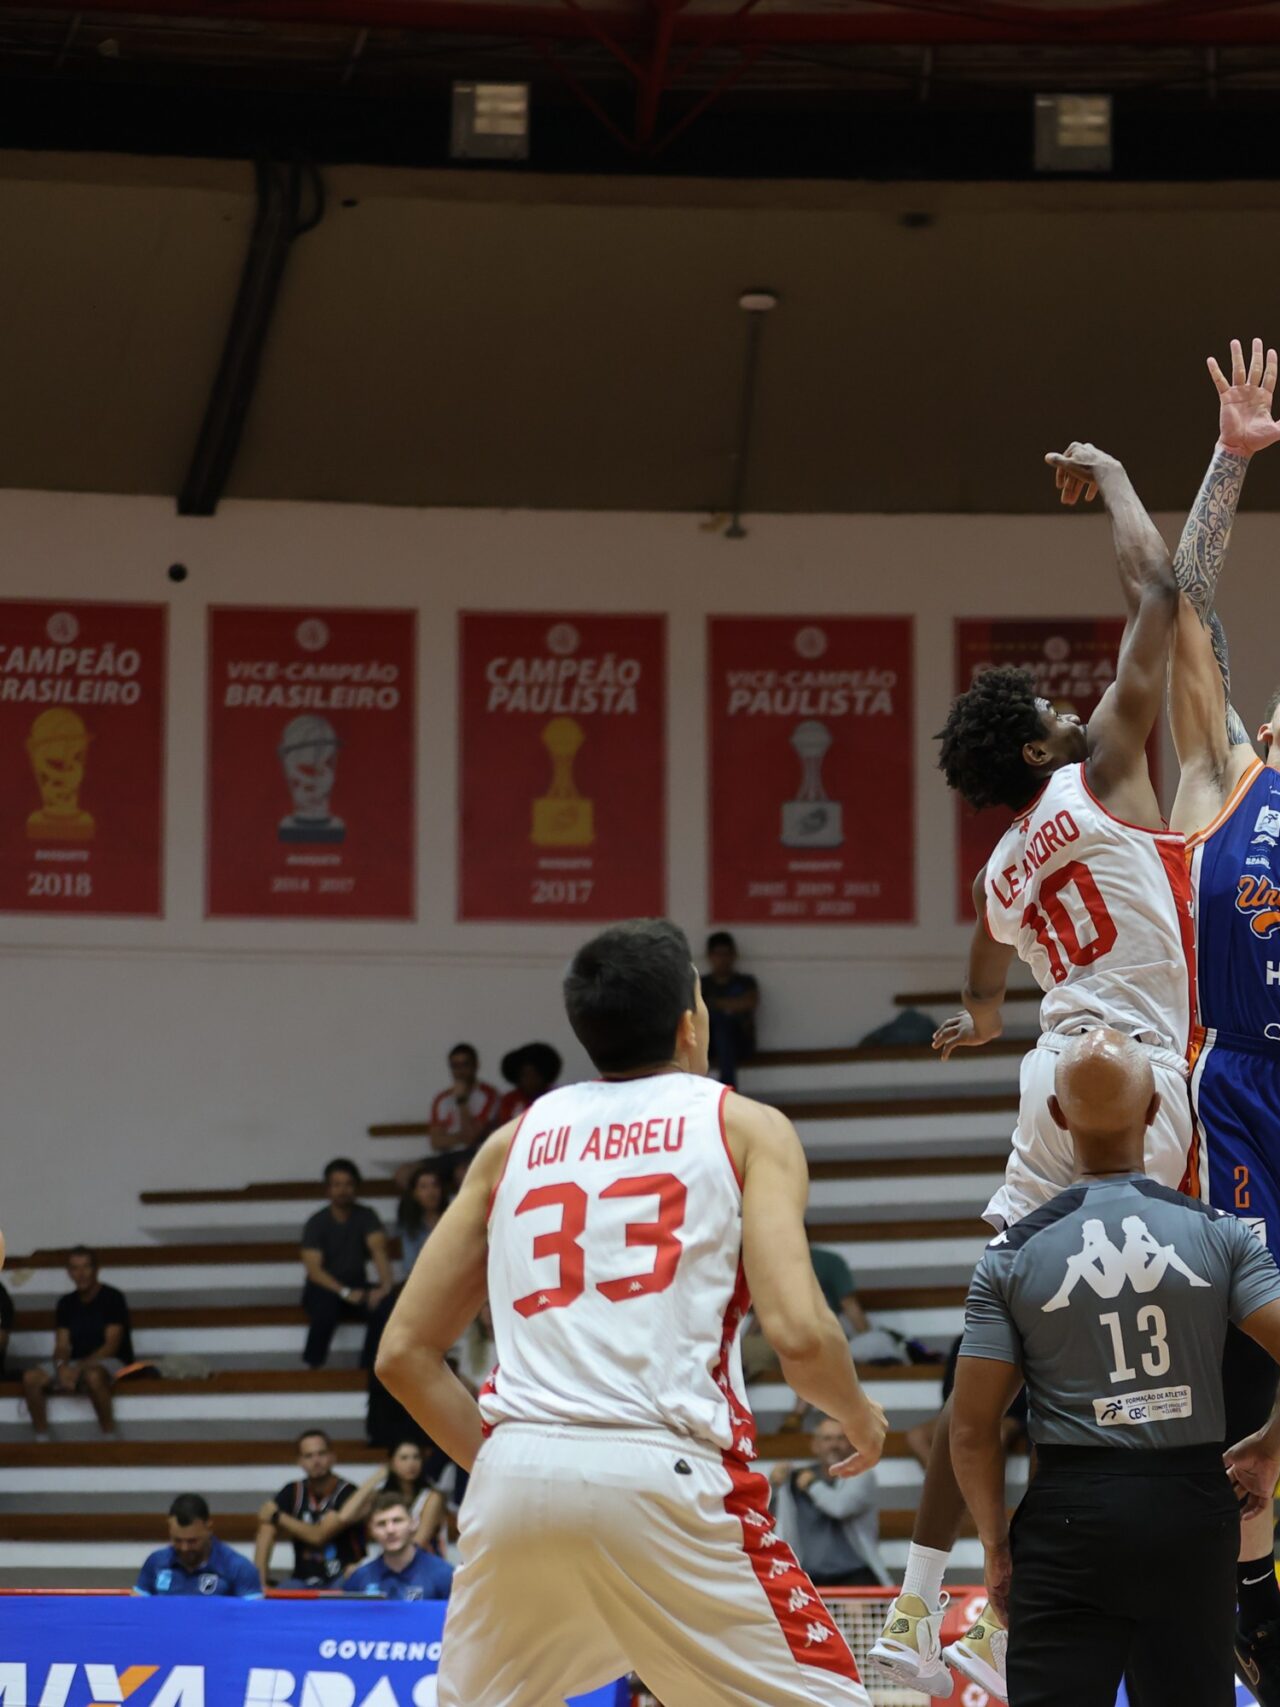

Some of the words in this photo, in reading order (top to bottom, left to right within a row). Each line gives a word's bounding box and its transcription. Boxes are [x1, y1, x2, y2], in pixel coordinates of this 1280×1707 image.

[0, 643, 141, 677] AMPEÃO
[227, 660, 399, 683] VICE-CAMPEÃO
[486, 653, 641, 687] CAMPEÃO
[0, 678, 141, 704] RASILEIRO
[726, 666, 898, 690] VICE-CAMPEÃO
[224, 684, 399, 709] BRASILEIRO
[487, 684, 639, 714] PAULISTA
[726, 689, 894, 716] PAULISTA
[28, 872, 93, 897] 2018
[531, 879, 595, 904] 2017
[1020, 860, 1118, 985] 10
[527, 1125, 571, 1171] GUI
[579, 1116, 685, 1162] ABREU
[1233, 1165, 1250, 1209] 2
[512, 1172, 688, 1319] 33
[1098, 1304, 1171, 1384] 13
[1164, 1389, 1188, 1399] ATLETAS
[318, 1638, 443, 1662] GOVERNO
